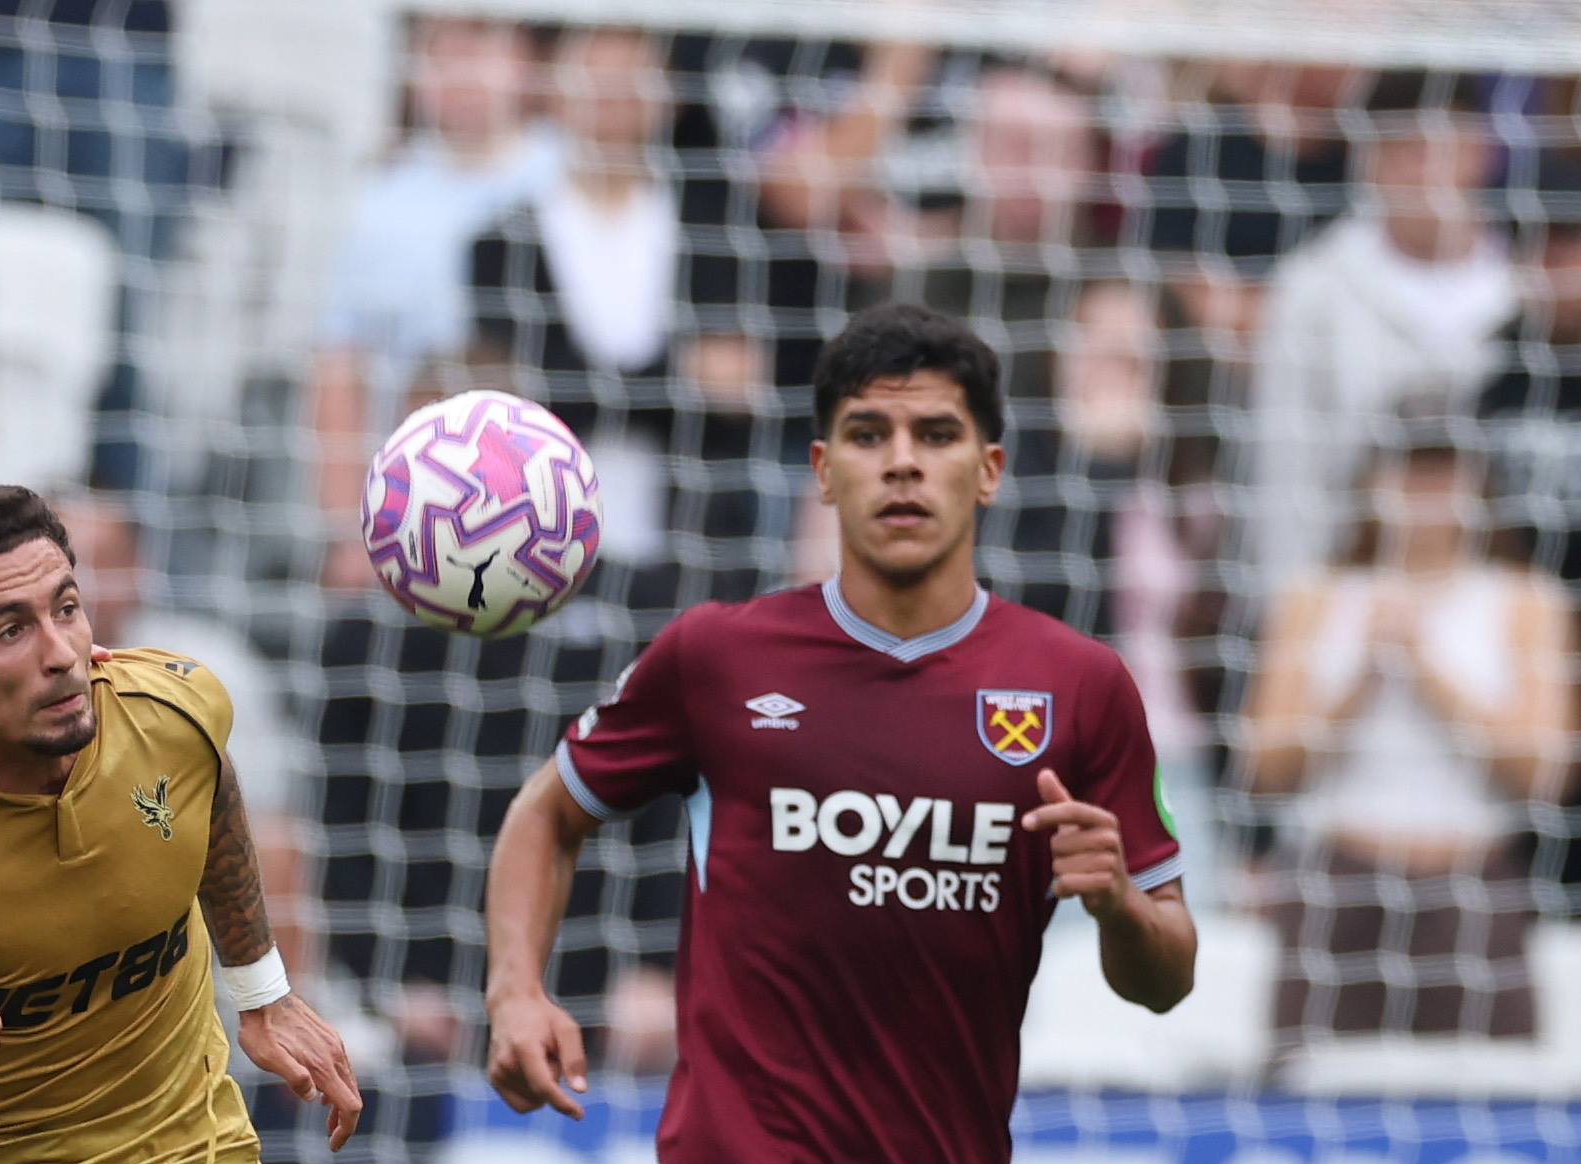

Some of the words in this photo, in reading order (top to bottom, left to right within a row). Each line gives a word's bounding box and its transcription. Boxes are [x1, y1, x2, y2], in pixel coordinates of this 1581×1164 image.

[751, 716, 799, 731] umbro
[770, 787, 1016, 865] BOYLE
[848, 863, 1001, 913] SPORTS
